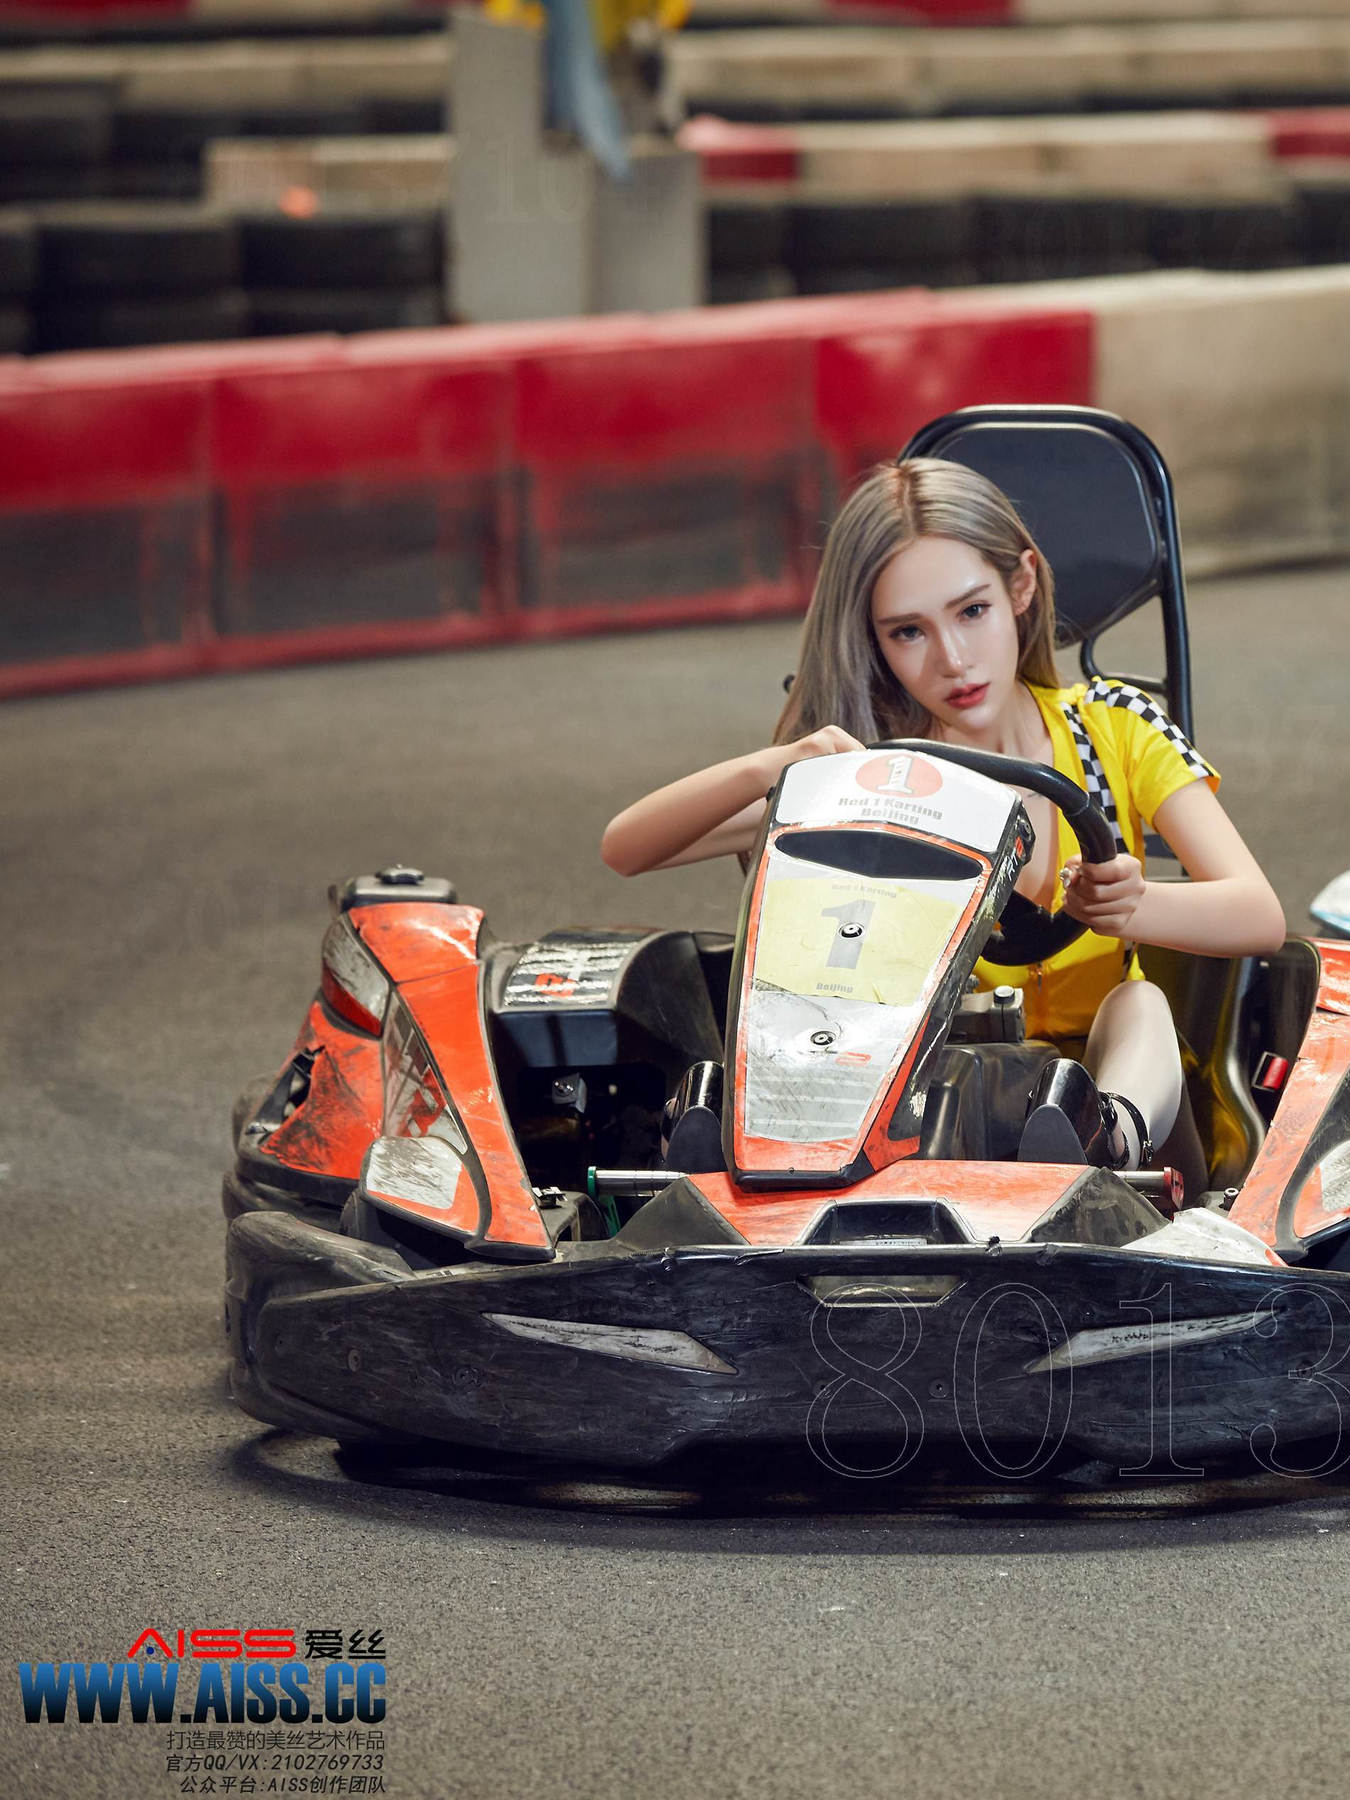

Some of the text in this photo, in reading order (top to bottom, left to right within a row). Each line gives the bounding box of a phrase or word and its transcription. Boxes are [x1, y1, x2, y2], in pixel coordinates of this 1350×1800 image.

[877, 756, 914, 794] 1
[838, 798, 868, 806] Red
[884, 797, 942, 820] Karting
[861, 807, 919, 825] Beijing
[821, 899, 876, 969] 1
[816, 983, 853, 993] Beijing
